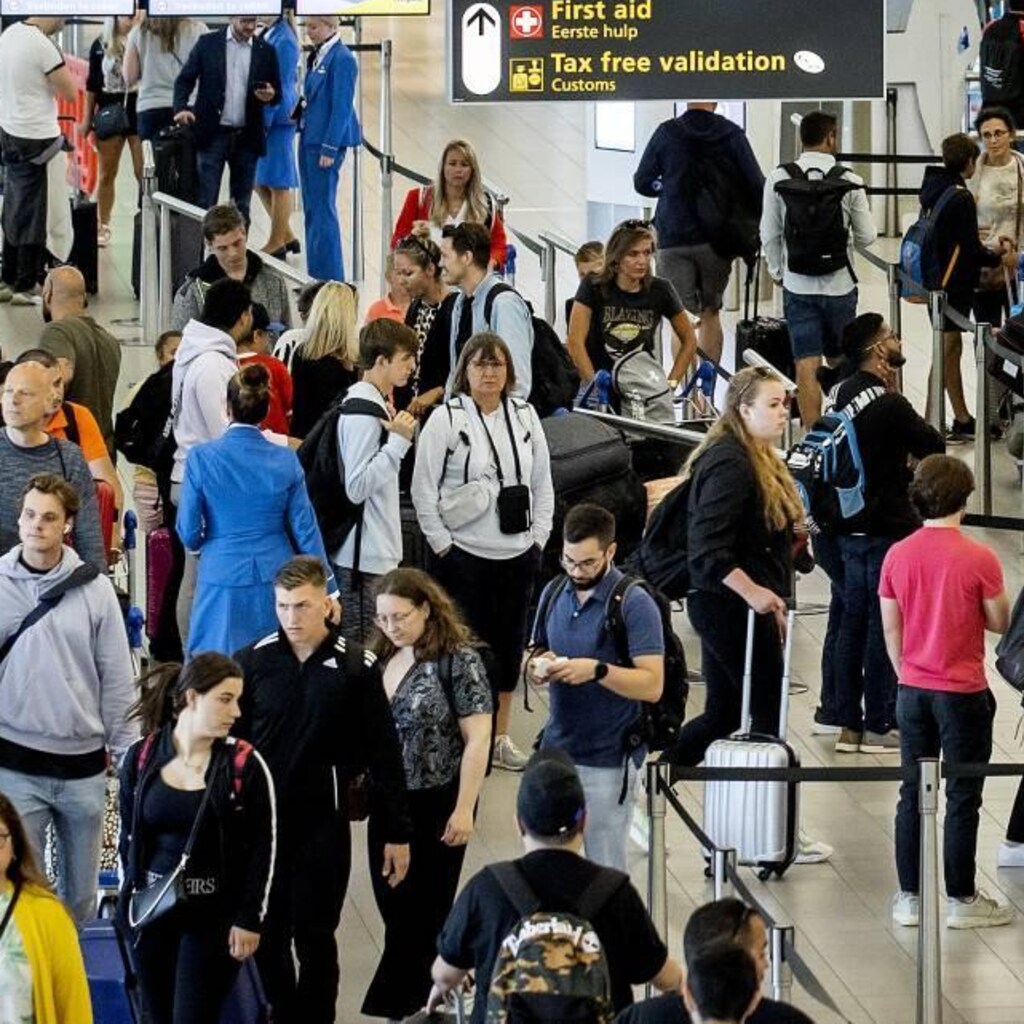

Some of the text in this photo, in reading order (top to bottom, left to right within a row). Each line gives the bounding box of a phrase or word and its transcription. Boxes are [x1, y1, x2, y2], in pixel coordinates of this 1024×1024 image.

[551, 0, 606, 20] First
[552, 24, 638, 41] Eerste hulp
[551, 50, 786, 73] Tax free validation
[551, 78, 616, 93] Customs
